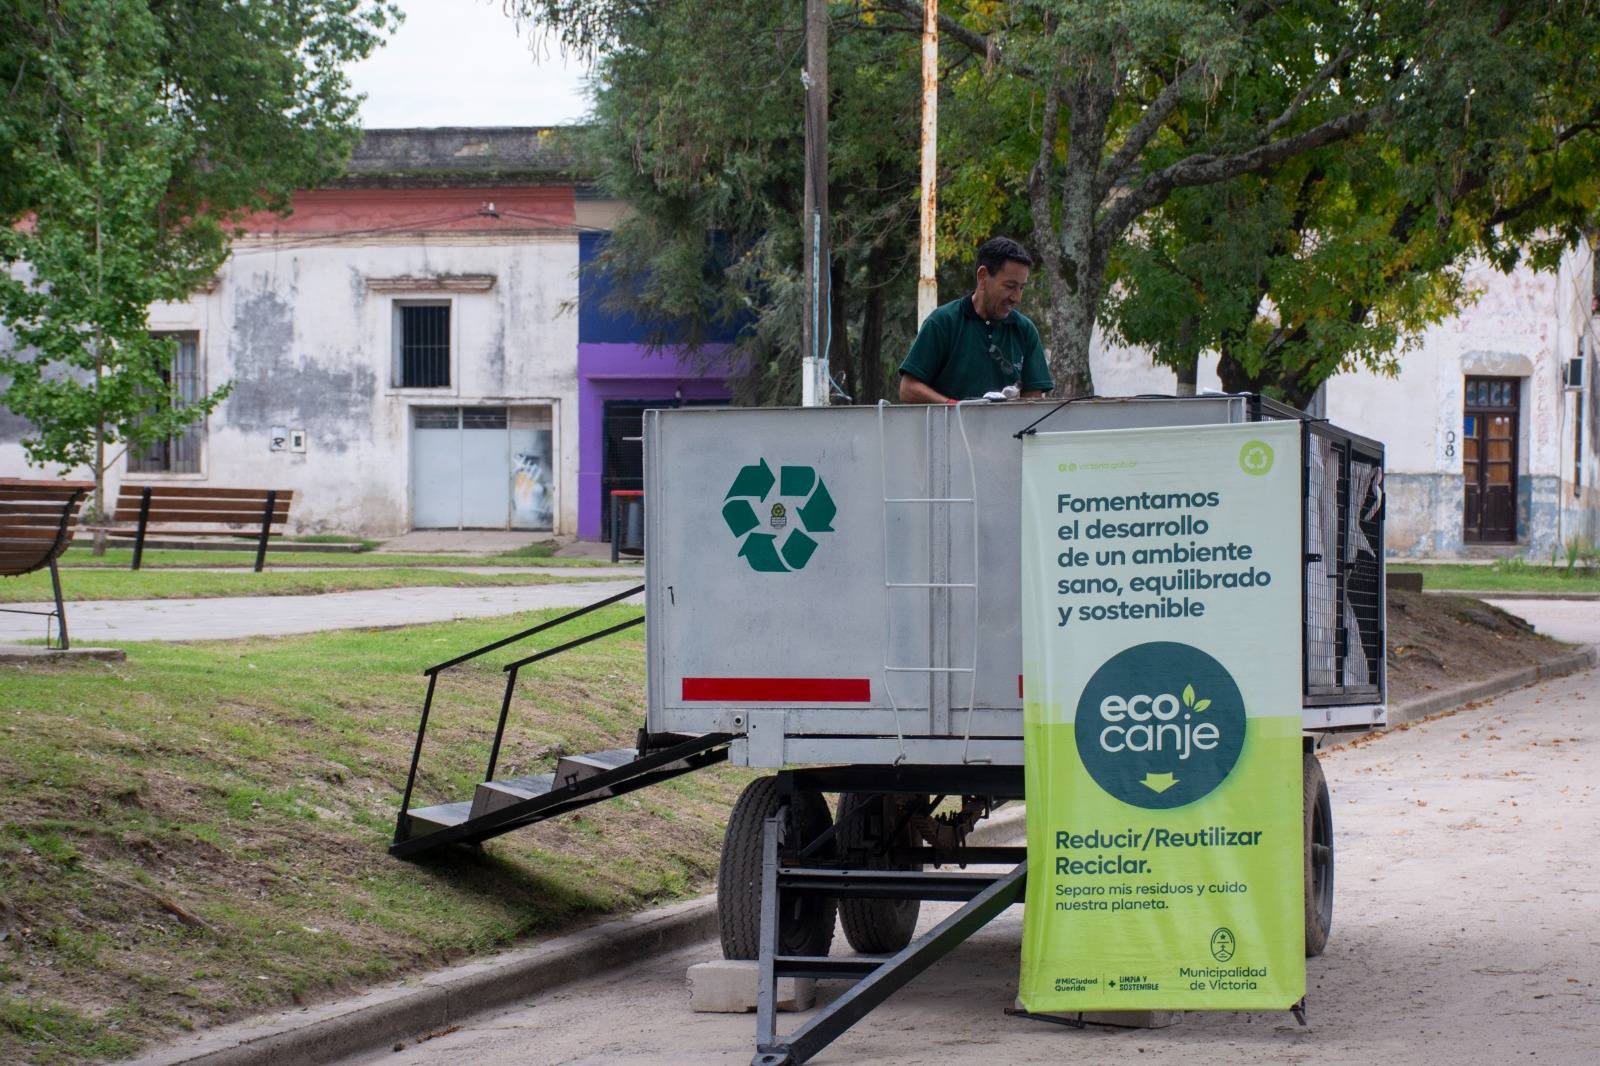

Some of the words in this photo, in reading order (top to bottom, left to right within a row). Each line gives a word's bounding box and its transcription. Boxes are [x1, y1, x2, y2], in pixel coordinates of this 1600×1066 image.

[1057, 491, 1220, 514] Fomentamos
[1057, 520, 1079, 540] el
[1085, 515, 1209, 539] desarrollo
[1057, 547, 1089, 568] de
[1095, 550, 1126, 566] un
[1132, 541, 1253, 564] ambiente
[1057, 577, 1124, 597] sano,
[1129, 567, 1272, 596] equilibrado
[1057, 606, 1073, 627] y
[1078, 597, 1205, 621] sostenible
[1100, 693, 1180, 722] eco
[1100, 713, 1220, 760] canje
[1055, 827, 1263, 851] Reducir/Reutilizar
[1055, 855, 1152, 875] Reciclar.
[1055, 884, 1105, 898] Separo
[1109, 882, 1132, 895] mis
[1136, 882, 1193, 895] residuos
[1197, 884, 1206, 896] y
[1208, 881, 1248, 894] cuido
[1055, 900, 1108, 911] nuestra
[1111, 898, 1169, 912] planeta.
[1055, 977, 1098, 985] #MiCiudad
[1179, 966, 1267, 980] Municipalidad
[1055, 984, 1086, 992] Querida
[1189, 980, 1206, 991] de
[1209, 979, 1257, 990] Victoria
